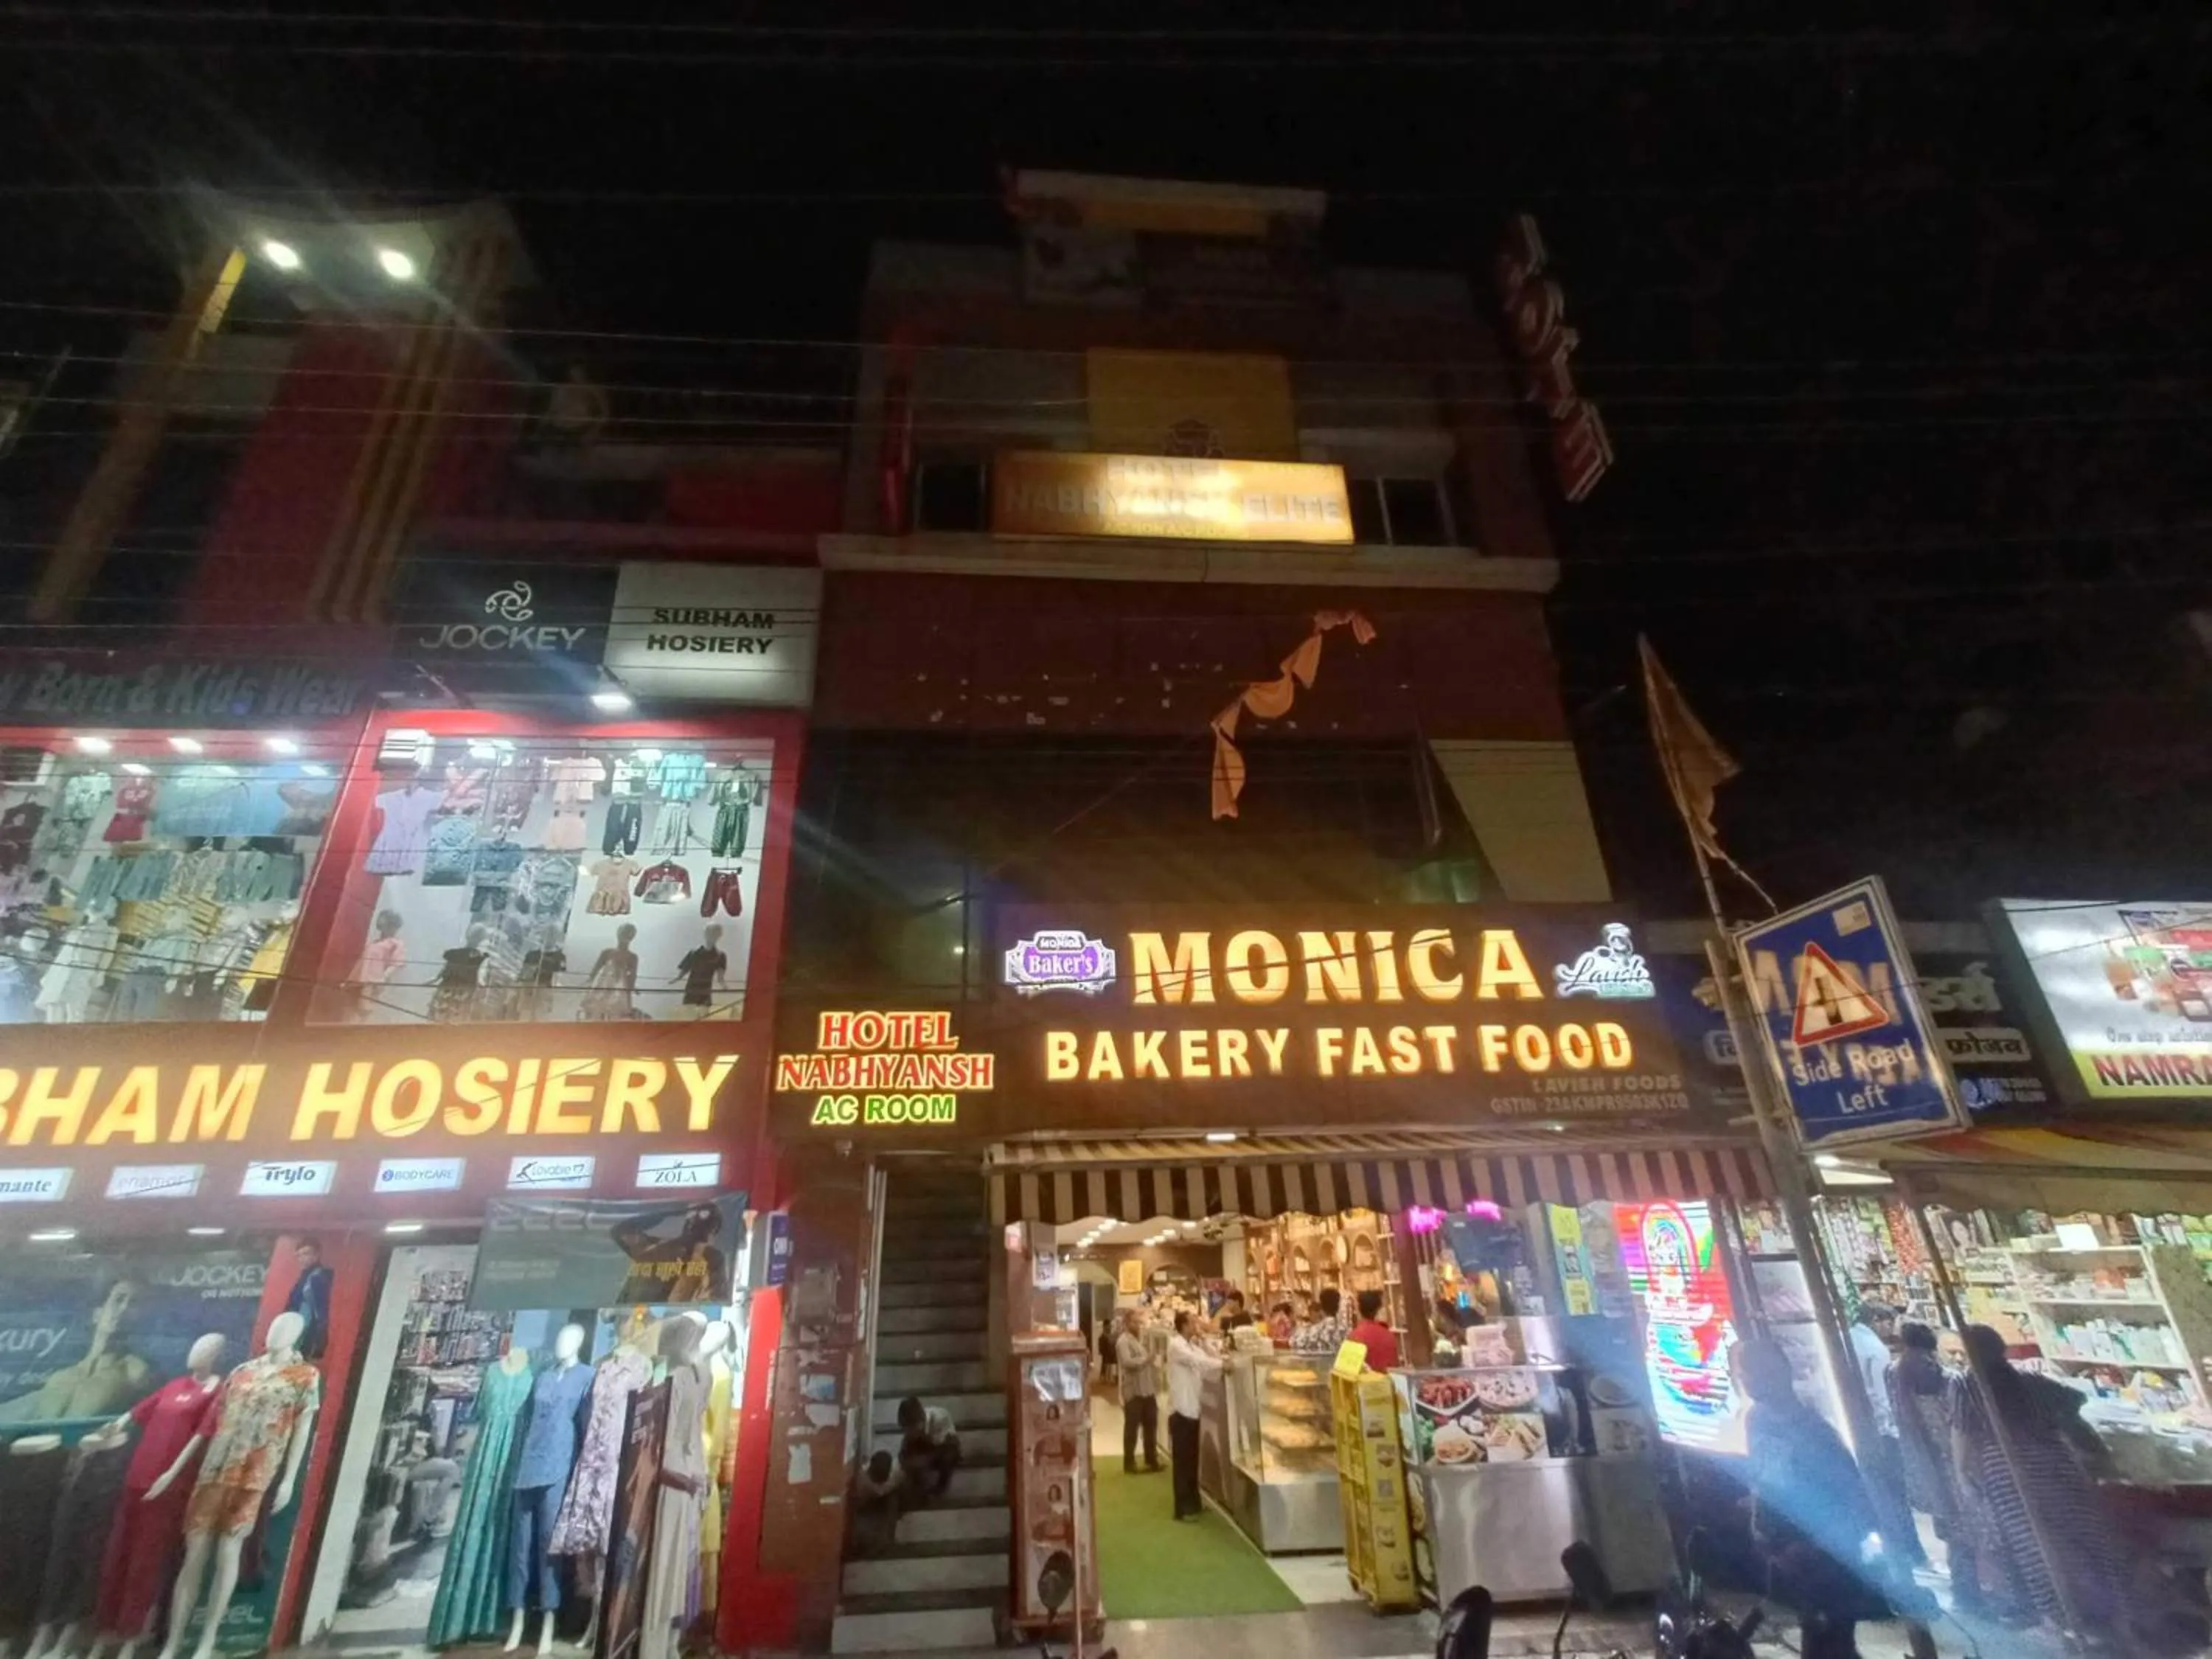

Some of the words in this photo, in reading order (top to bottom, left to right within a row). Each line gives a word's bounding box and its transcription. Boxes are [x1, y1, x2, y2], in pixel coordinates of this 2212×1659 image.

[653, 608, 773, 629] SUBHAM
[419, 624, 588, 652] JOCKEY
[647, 634, 773, 655] HOSIERY
[1028, 953, 1093, 974] Baker's
[1128, 928, 1545, 1004] MONICA
[818, 1010, 959, 1050] HOTEL
[1046, 1028, 1290, 1082] BAKERY
[1316, 1025, 1457, 1077] FAST
[1477, 1022, 1632, 1074] FOOD
[1792, 1061, 1843, 1087] Side
[1846, 1038, 1916, 1069] Road
[776, 1053, 995, 1091] NABHYANSH
[1532, 1076, 1605, 1093] LAVISH
[1613, 1074, 1682, 1091] FOODS
[290, 1054, 740, 1141] HOSIERY
[811, 1094, 859, 1125] AC
[863, 1093, 956, 1124] ROOM
[1835, 1085, 1888, 1114] Left
[262, 1165, 317, 1186] Trylo
[394, 1168, 454, 1181] BODYCARE
[654, 1169, 698, 1183] ZOLA
